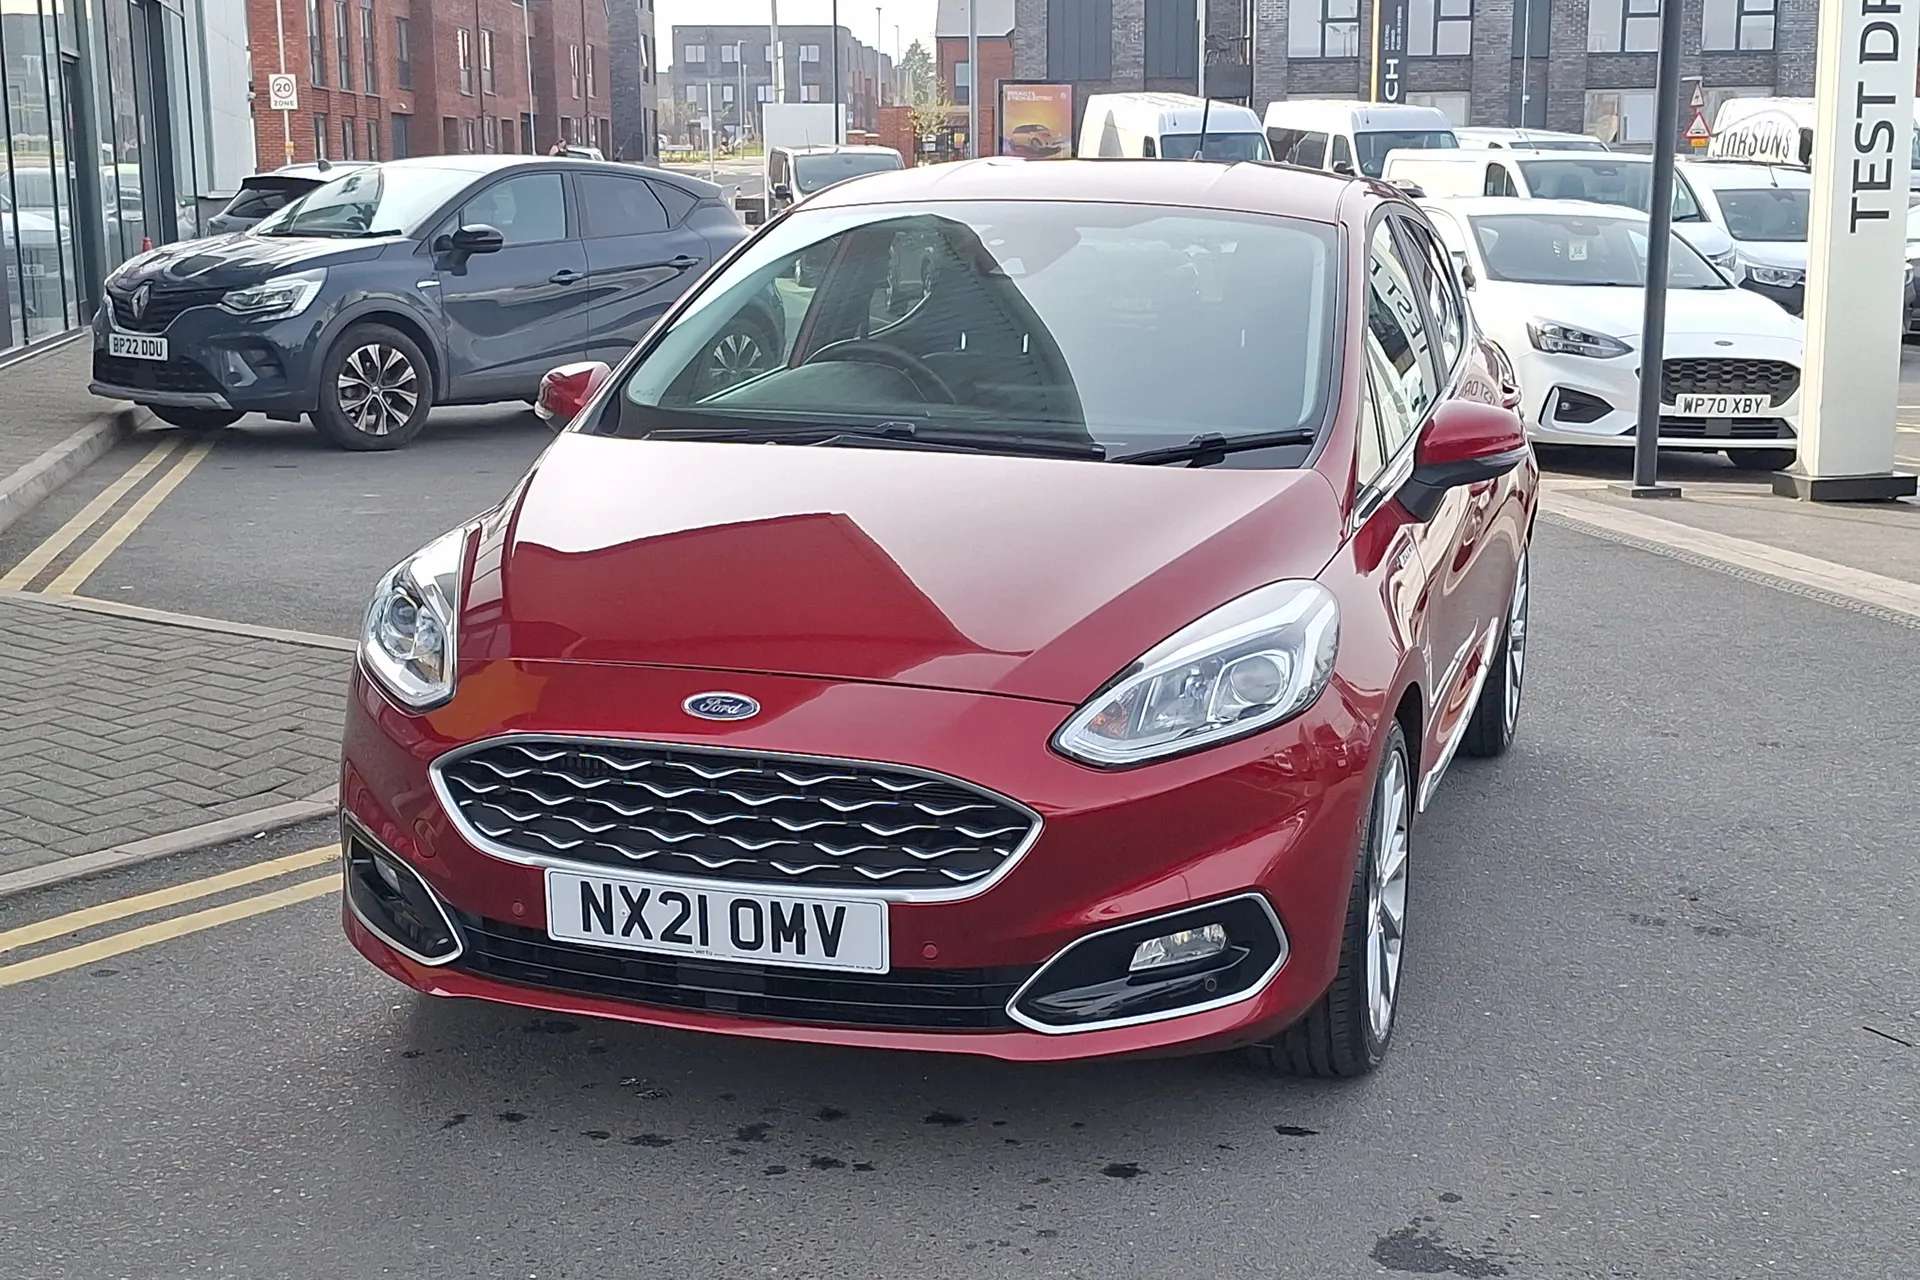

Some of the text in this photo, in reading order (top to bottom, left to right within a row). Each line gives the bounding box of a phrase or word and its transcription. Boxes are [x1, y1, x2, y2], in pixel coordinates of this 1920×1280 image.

[275, 82, 290, 92] 20
[1850, 81, 1897, 233] TEST
[113, 337, 163, 357] BP22 DDU
[1683, 397, 1763, 414] WP70 XBY
[700, 697, 743, 714] Ford
[580, 880, 847, 958] NX21 OMV
